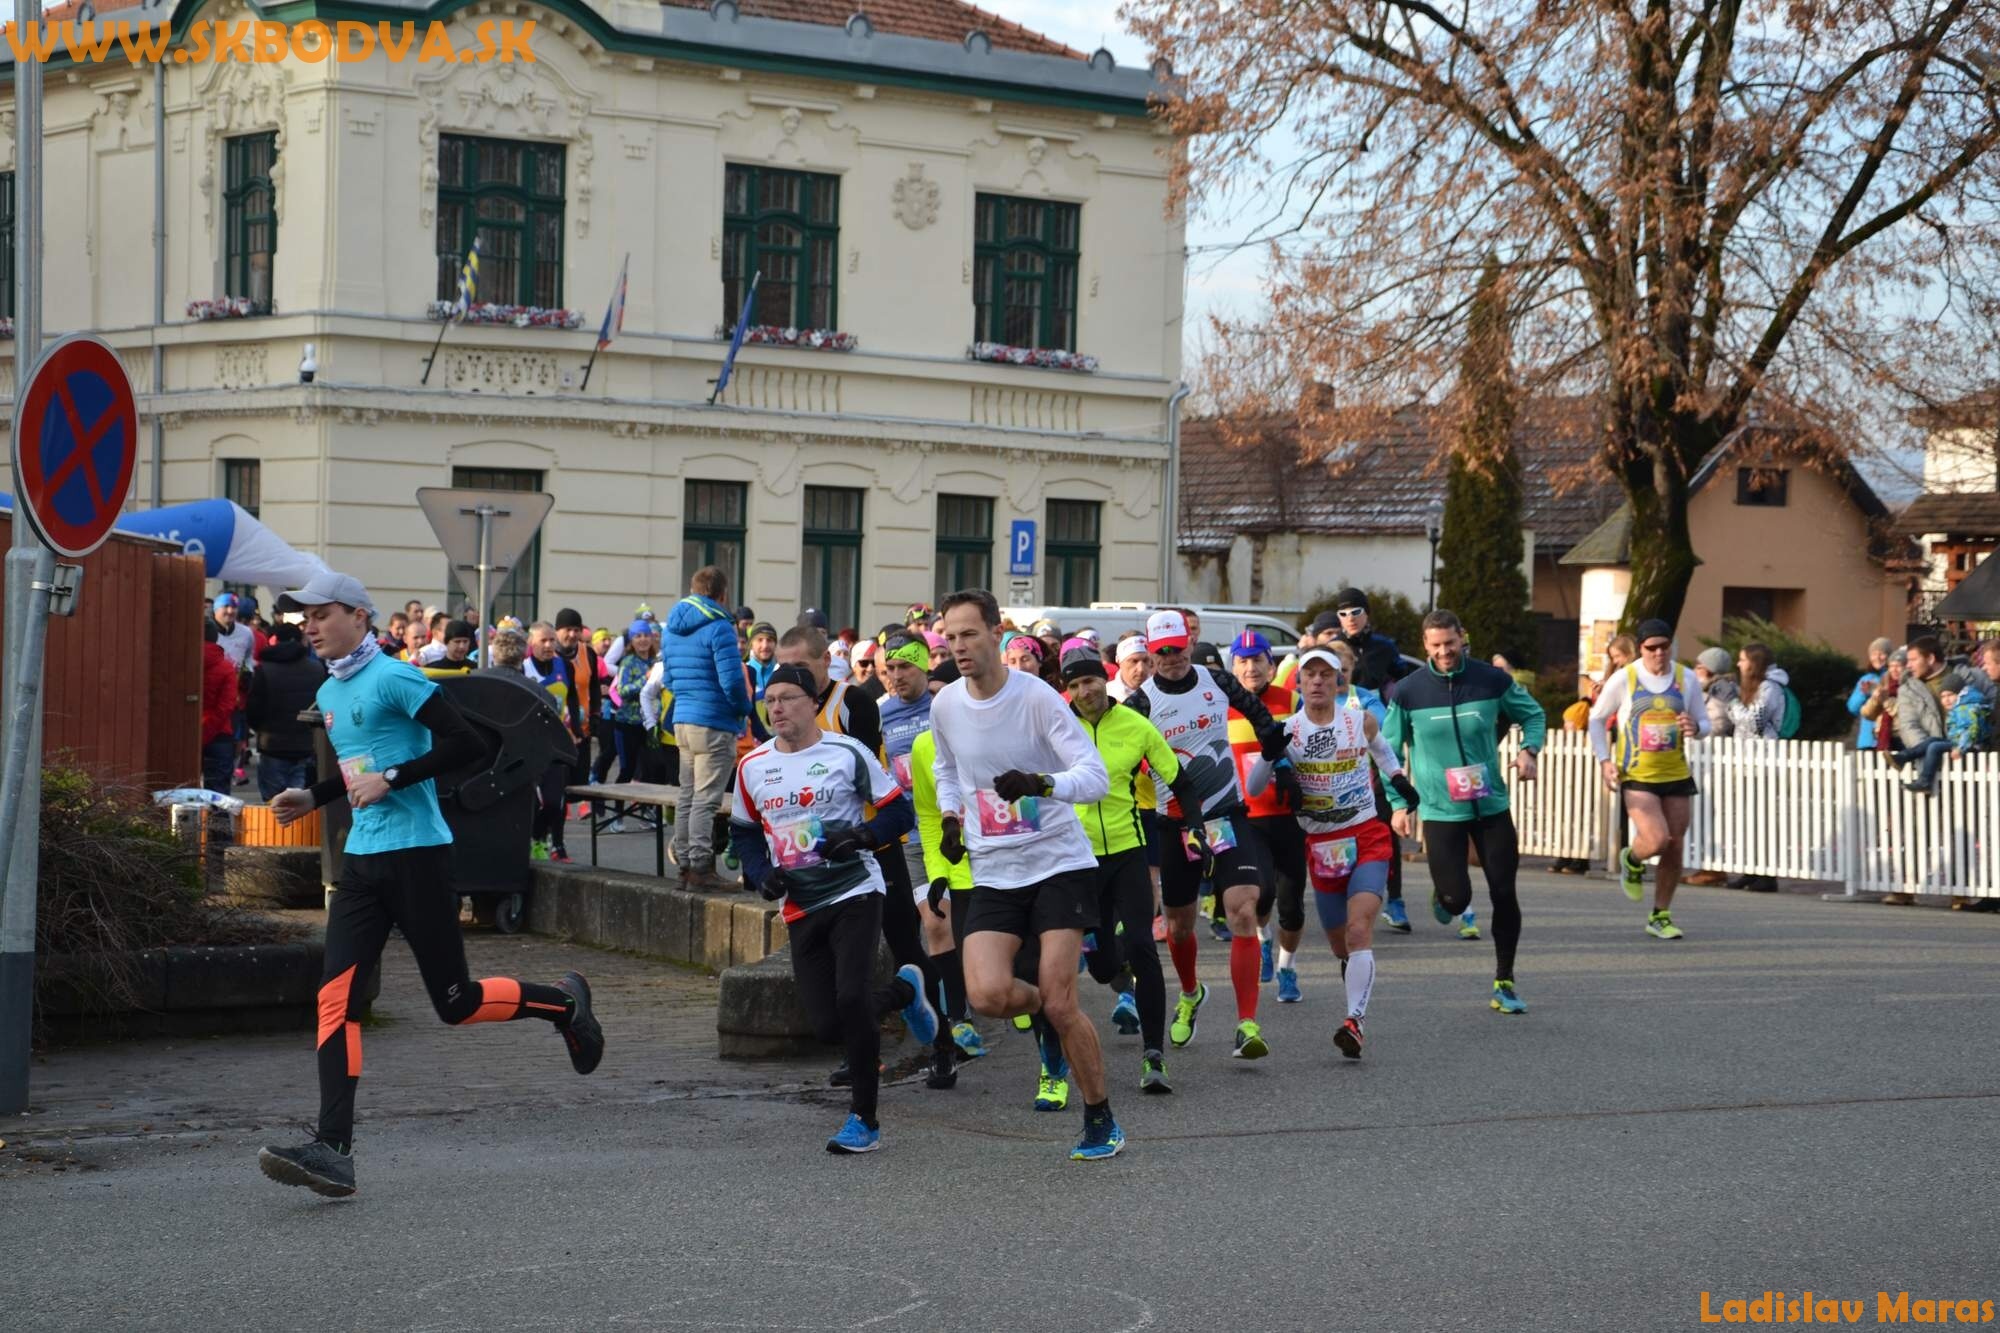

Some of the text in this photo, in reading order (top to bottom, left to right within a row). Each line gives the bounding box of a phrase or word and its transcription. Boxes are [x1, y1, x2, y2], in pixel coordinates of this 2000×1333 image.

[1017, 530, 1030, 562] P
[1307, 726, 1335, 745] EEZY
[1647, 724, 1671, 745] 35
[1457, 772, 1484, 792] 93
[779, 828, 813, 856] 20
[1322, 847, 1349, 869] 44
